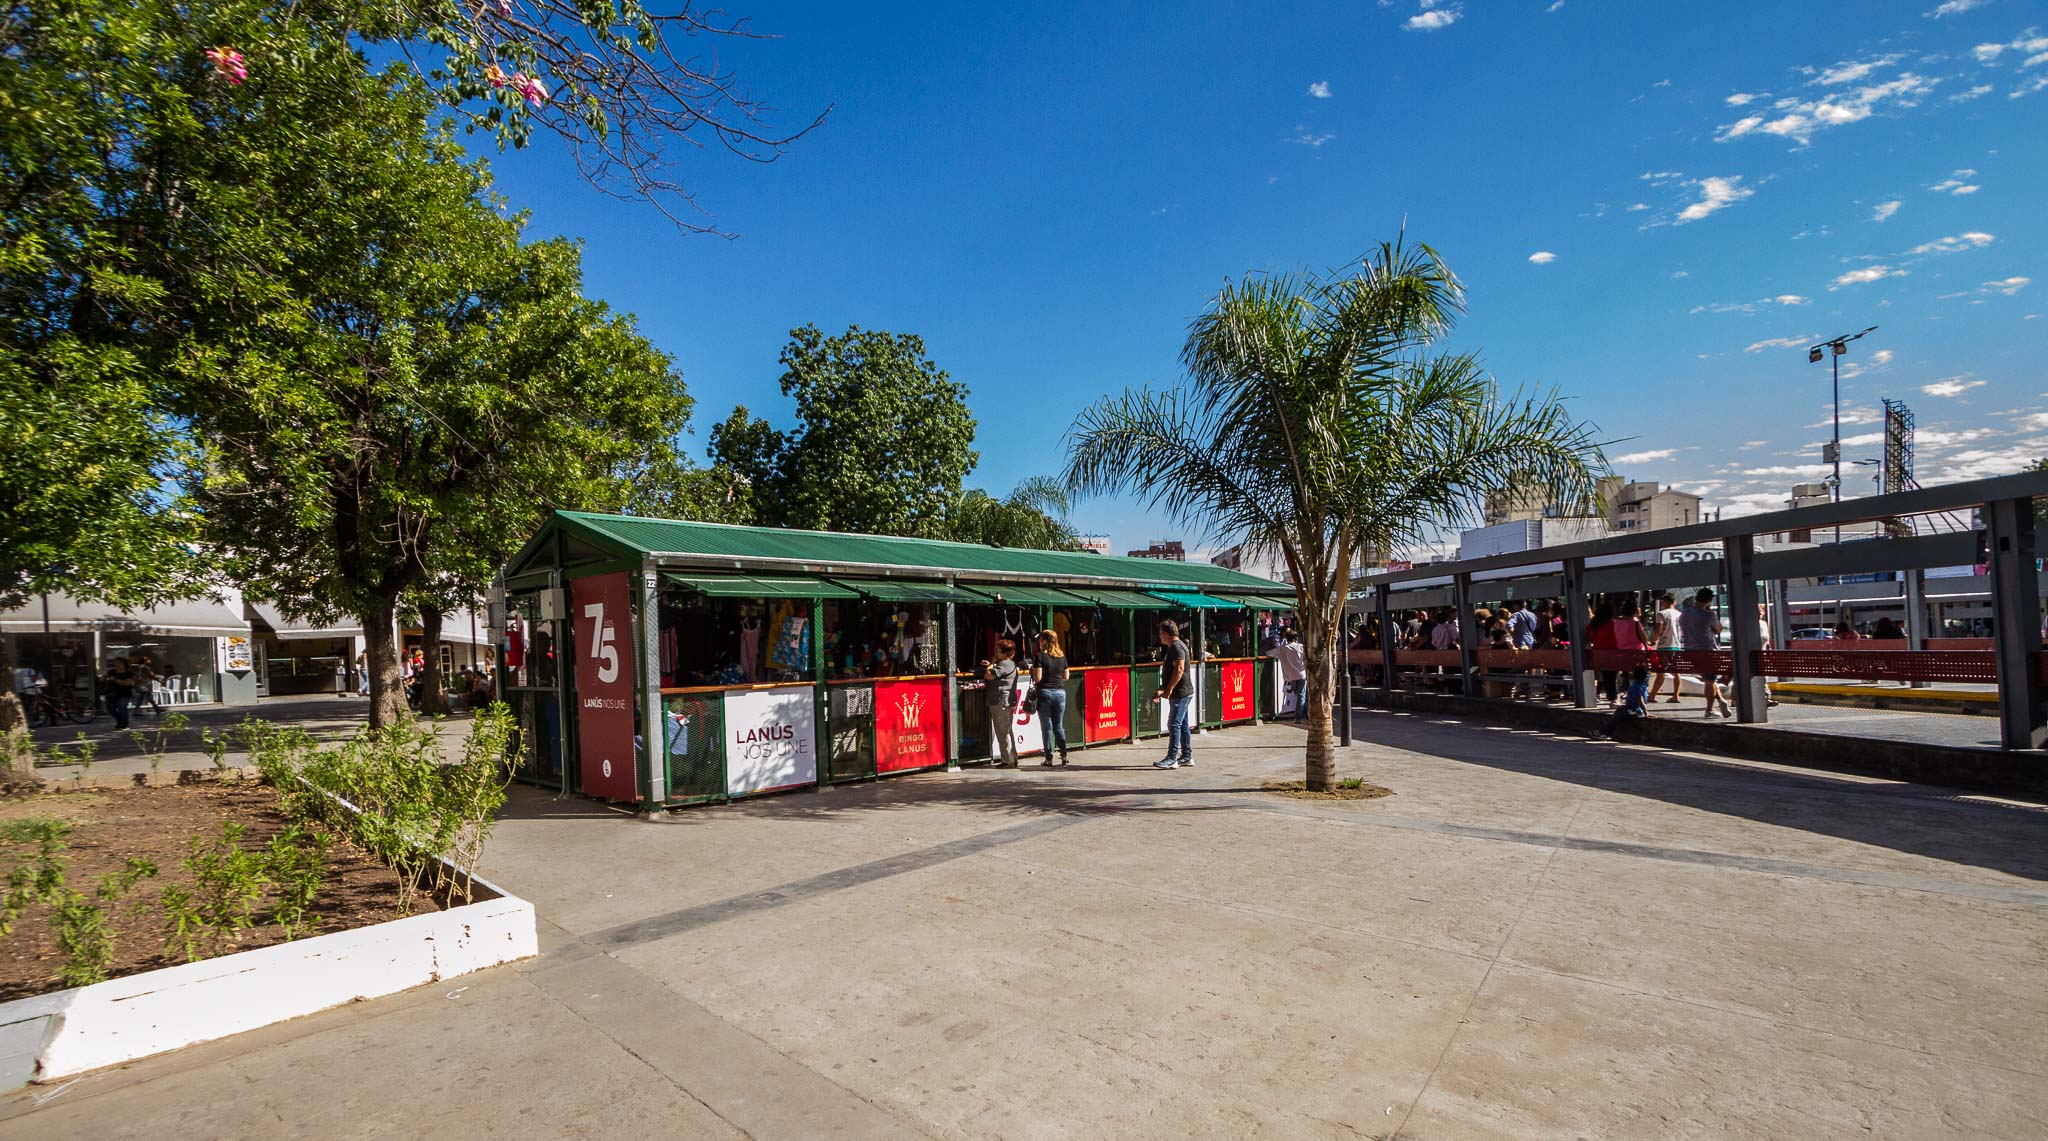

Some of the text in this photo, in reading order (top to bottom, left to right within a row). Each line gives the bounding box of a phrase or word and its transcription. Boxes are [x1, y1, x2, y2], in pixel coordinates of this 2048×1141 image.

[584, 603, 619, 684] 75
[583, 696, 626, 709] LANÚS NOS UNE
[1100, 711, 1116, 719] BINGO
[1099, 720, 1118, 728] LANUS
[736, 722, 794, 744] LANÚS
[899, 733, 924, 743] BINGO
[737, 738, 808, 760] NOS UNE
[898, 744, 927, 754] LANUS
